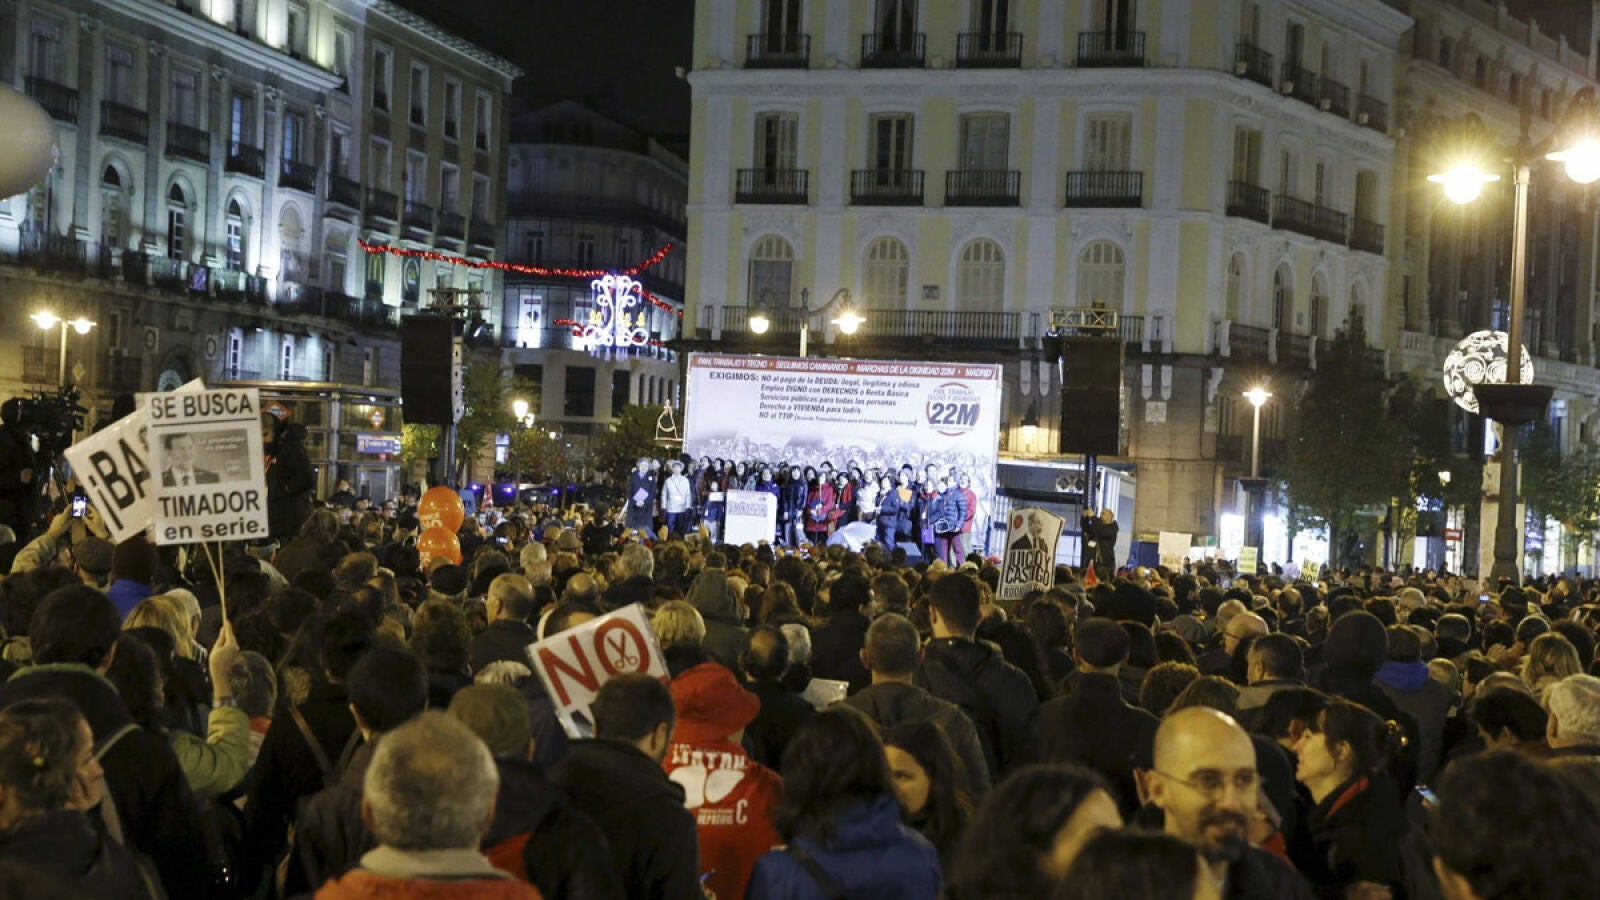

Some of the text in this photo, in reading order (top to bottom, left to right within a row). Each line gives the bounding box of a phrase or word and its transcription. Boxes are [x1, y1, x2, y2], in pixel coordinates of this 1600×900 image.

[713, 358, 740, 367] TRABAJO
[776, 360, 808, 370] SEGUIMOS
[809, 362, 848, 372] CAMINANDO
[856, 364, 888, 373] MARCHAS
[890, 365, 900, 373] DE
[900, 366, 908, 374] LA
[966, 368, 992, 377] MADRID
[710, 372, 759, 381] EXIGIMOS:
[780, 376, 796, 385] pago
[760, 393, 789, 401] Servicios
[761, 384, 784, 392] Empleo
[786, 385, 807, 393] DIGNO
[822, 386, 858, 395] DERECHOS
[151, 393, 252, 418] SE BUSCA
[760, 402, 786, 410] Derecho
[794, 404, 824, 412] VIVIENDA
[930, 402, 980, 426] 22M
[158, 490, 260, 518] TIMADOR
[164, 517, 266, 540] en serie.
[1006, 566, 1050, 586] CASTIGO
[538, 618, 650, 707] NO
[736, 799, 748, 824] C
